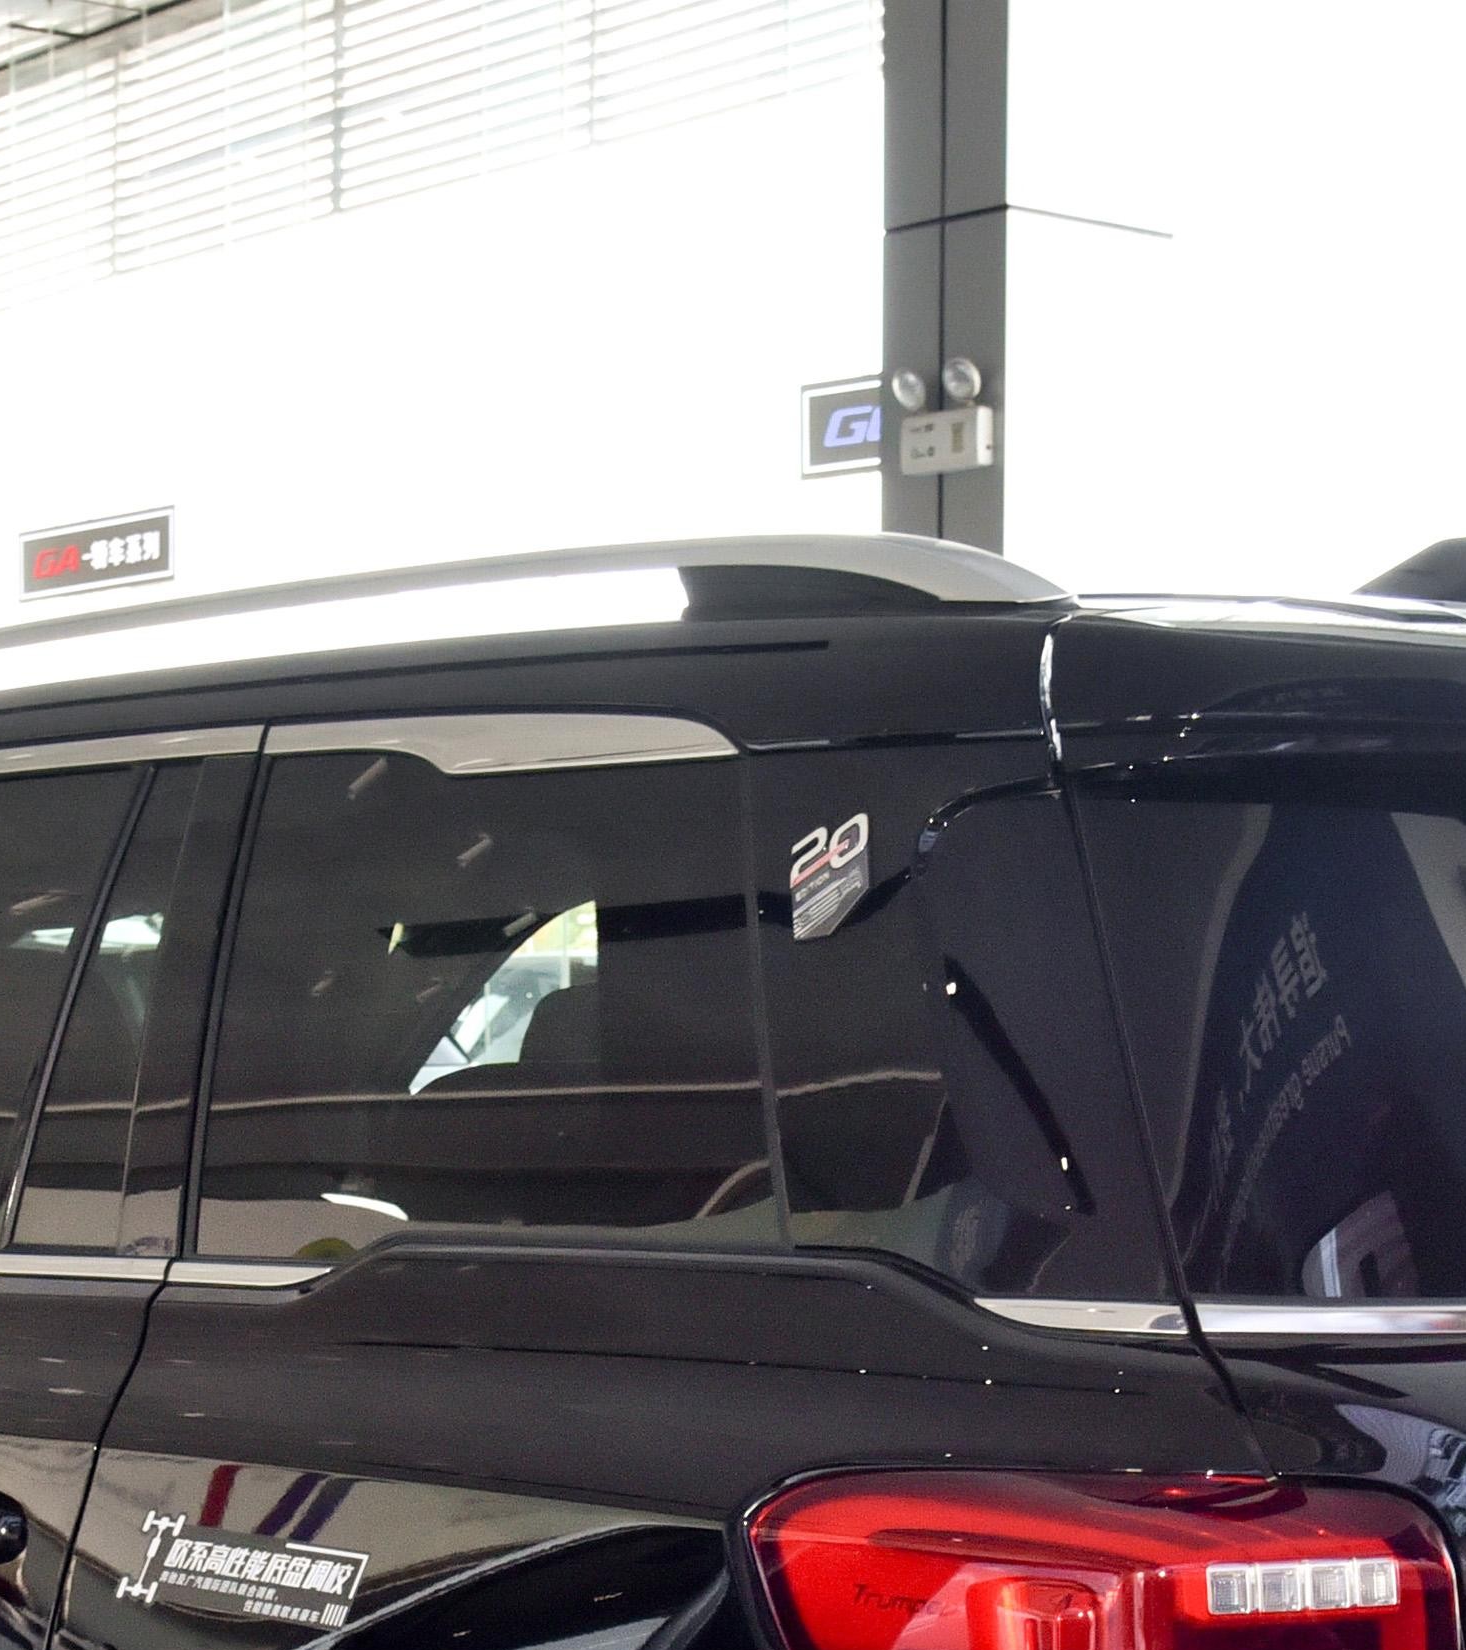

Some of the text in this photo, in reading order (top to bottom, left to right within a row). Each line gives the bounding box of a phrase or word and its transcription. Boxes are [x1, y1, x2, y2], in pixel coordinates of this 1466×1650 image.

[163, 1537, 355, 1595] 欧系高性能底盘调校
